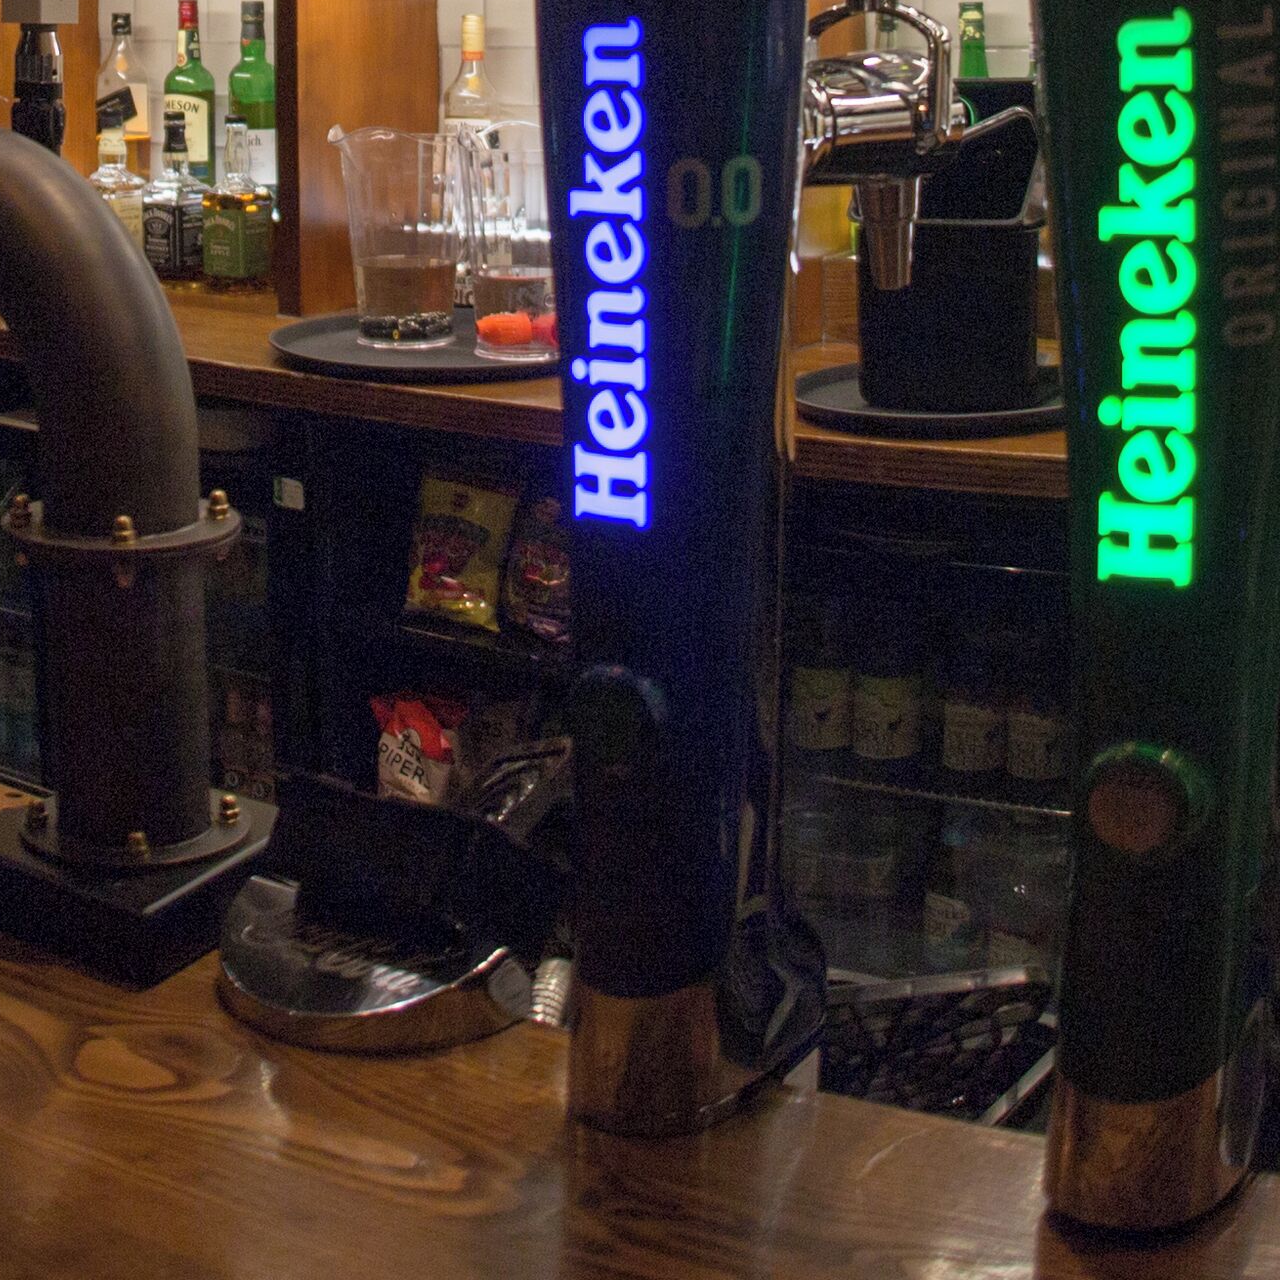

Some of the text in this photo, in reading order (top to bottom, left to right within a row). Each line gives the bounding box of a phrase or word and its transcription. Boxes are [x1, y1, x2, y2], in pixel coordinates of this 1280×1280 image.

[569, 17, 650, 528] Heineken
[667, 155, 763, 228] 0.0
[1097, 6, 1197, 588] Heineken
[1219, 6, 1277, 349] ORIGINAL
